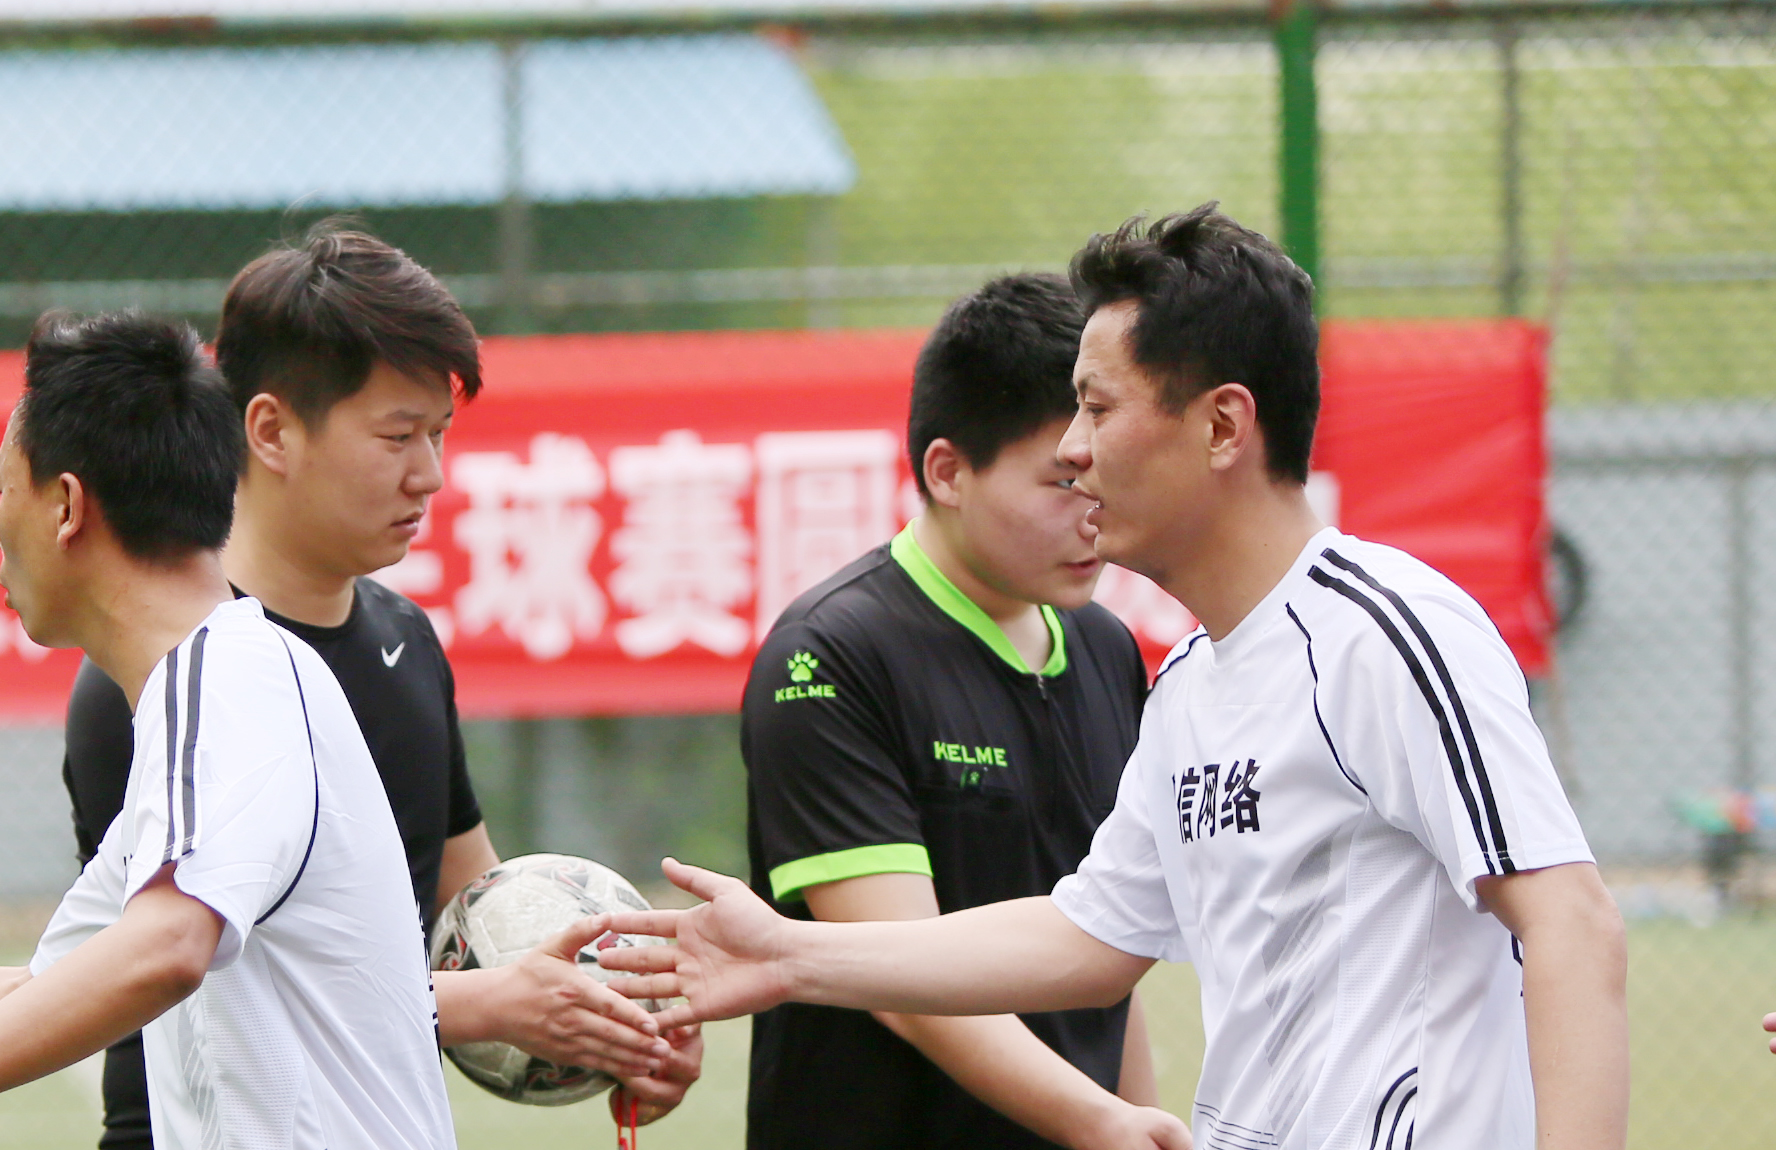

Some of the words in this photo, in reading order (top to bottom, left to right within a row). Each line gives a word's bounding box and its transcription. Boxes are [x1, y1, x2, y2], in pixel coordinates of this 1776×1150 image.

[775, 684, 836, 702] KELME
[934, 741, 1008, 767] KELME
[1172, 758, 1261, 844] 信网络
